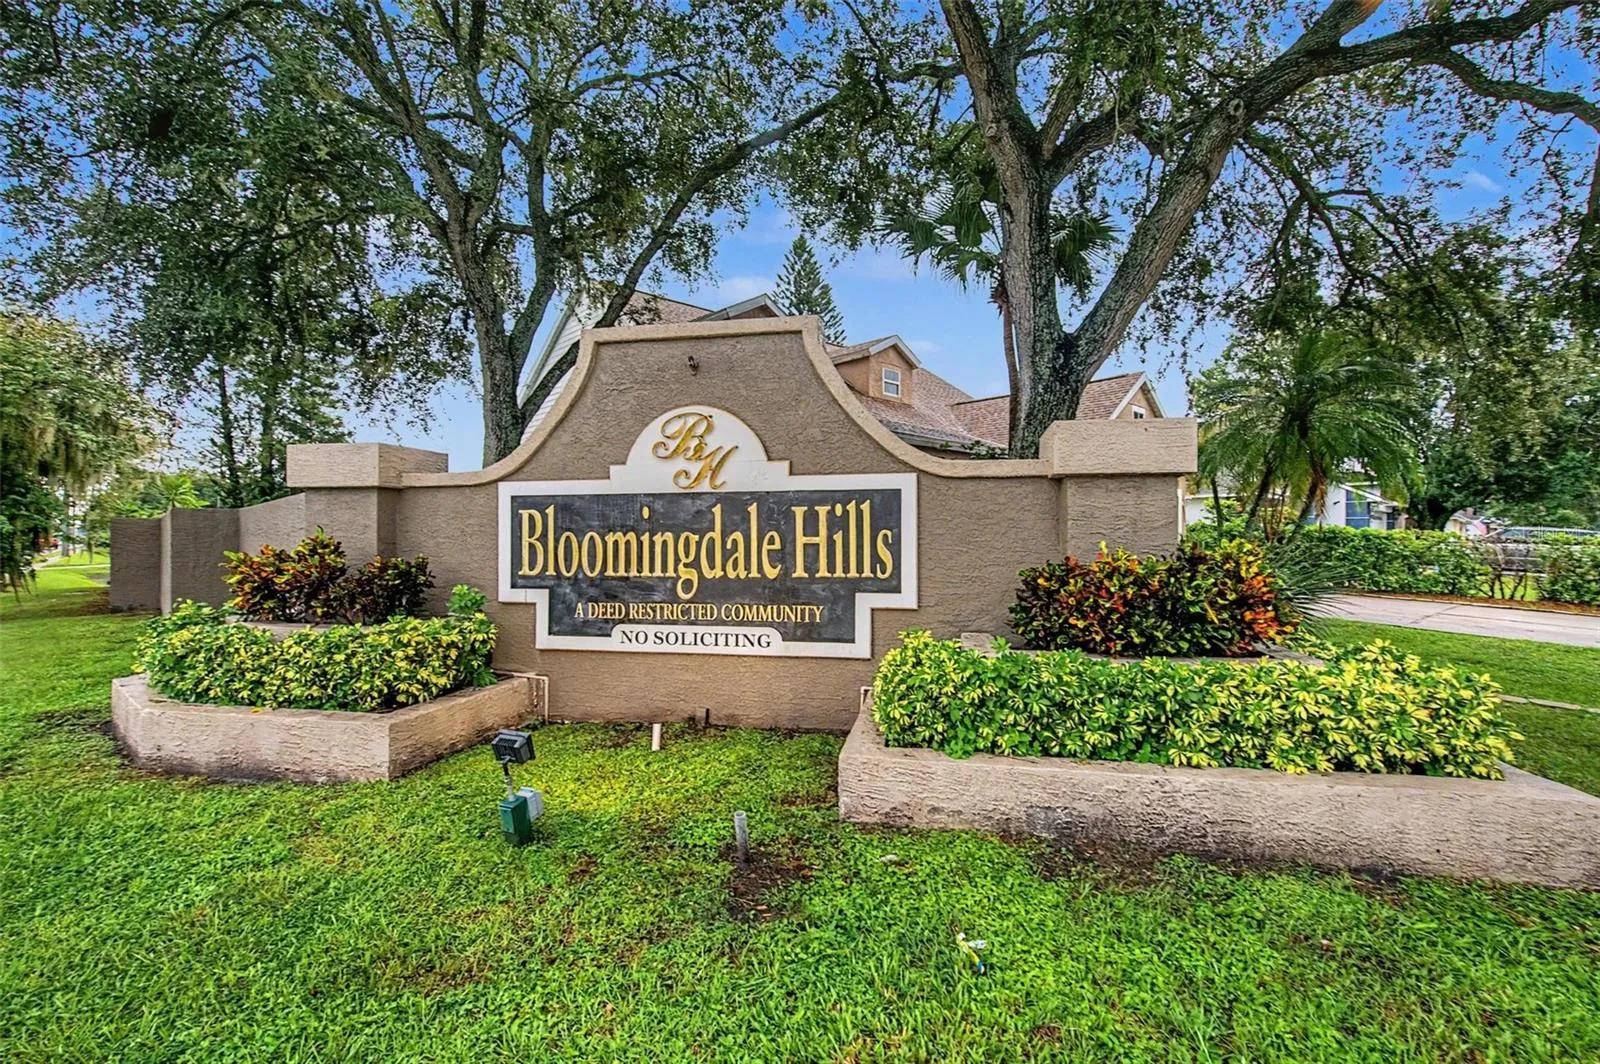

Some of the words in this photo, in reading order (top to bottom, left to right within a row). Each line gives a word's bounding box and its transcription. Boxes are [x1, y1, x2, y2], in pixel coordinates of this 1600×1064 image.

[518, 502, 782, 600] Bloomingdale
[791, 499, 893, 580] Hills
[574, 602, 584, 618] A
[588, 602, 625, 619] DEED
[629, 603, 718, 621] RESTRICTED
[721, 604, 824, 624] COMMUNITY
[620, 630, 649, 645] NO
[653, 631, 772, 649] SOLICITING
